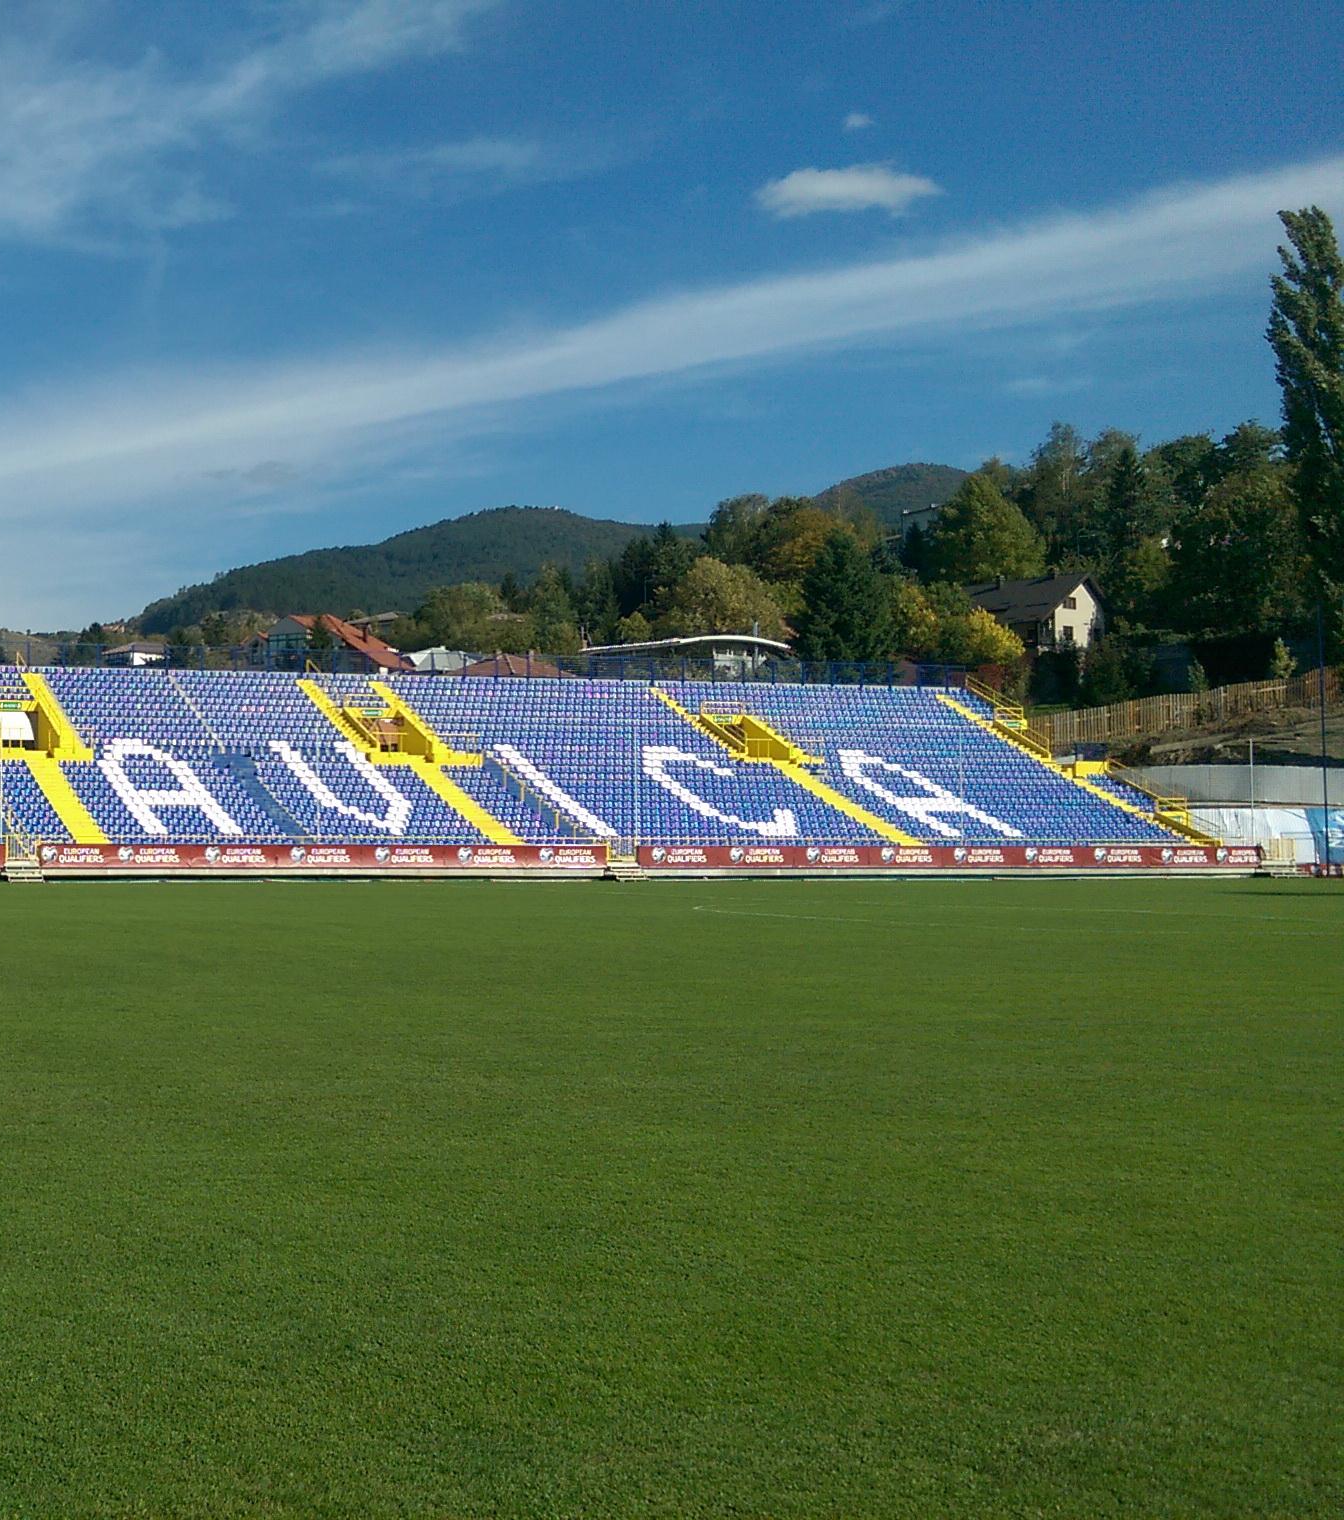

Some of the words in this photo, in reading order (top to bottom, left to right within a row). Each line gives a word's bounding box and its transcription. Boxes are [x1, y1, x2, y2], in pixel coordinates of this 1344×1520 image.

[63, 847, 101, 855] EUROPEAN
[139, 847, 176, 855] EUROPEAN
[477, 848, 512, 856] EUROPEAN
[559, 848, 593, 856] EUROPEAN
[58, 854, 105, 865] QUALIFIERS
[134, 854, 181, 864] QUALIFIERS
[221, 854, 267, 865] QUALIFIERS
[307, 854, 351, 865] QUALIFIERS
[391, 854, 434, 865] QUALIFIERS
[473, 855, 516, 866] QUALIFIERS
[554, 855, 597, 866] QUALIFIERS
